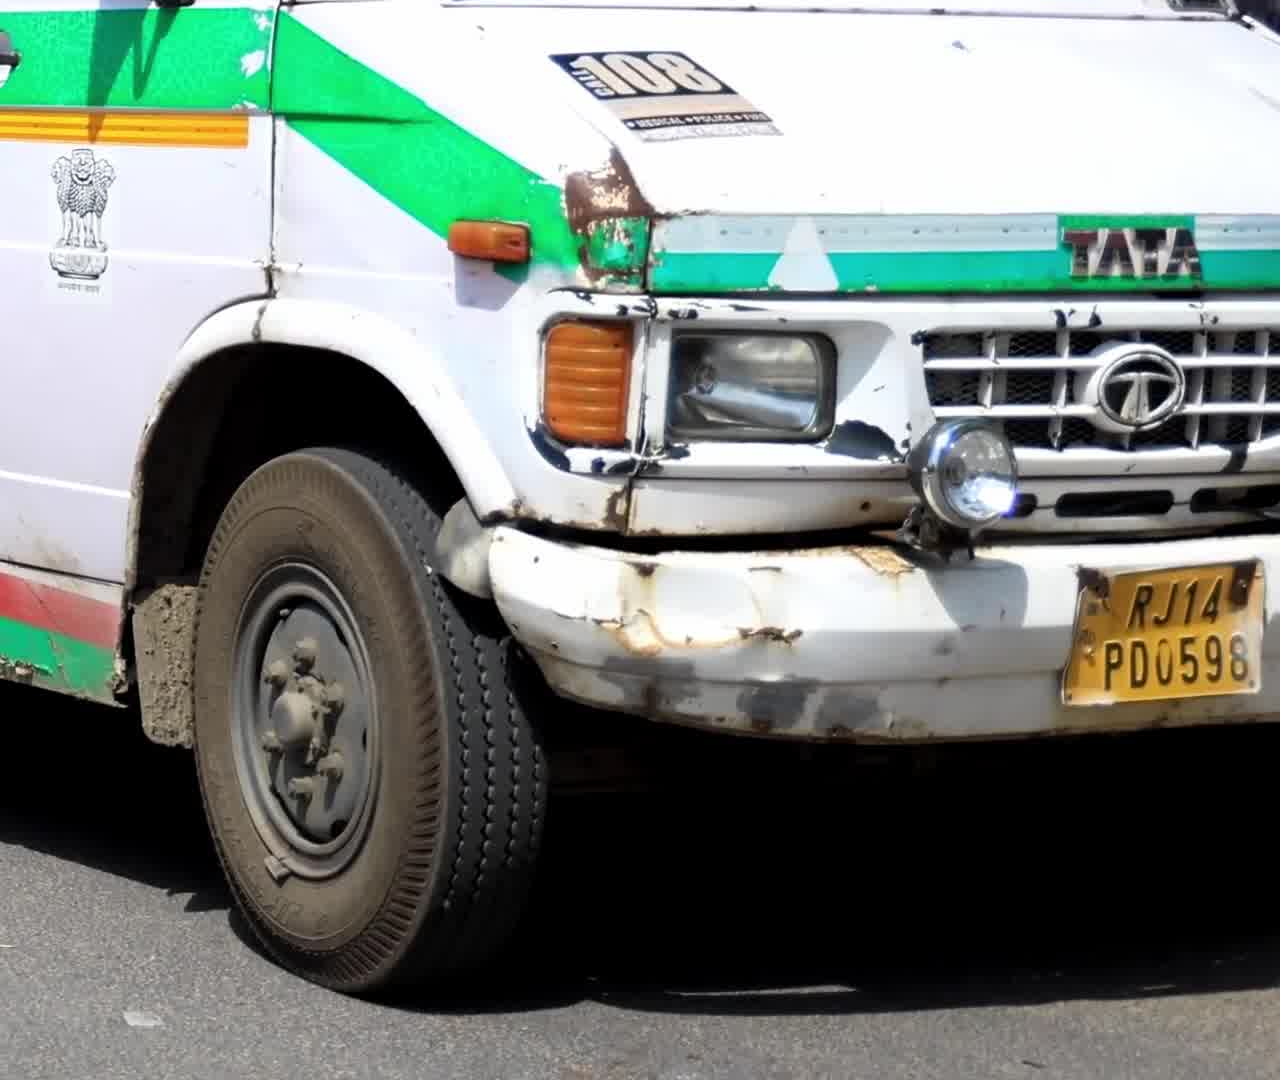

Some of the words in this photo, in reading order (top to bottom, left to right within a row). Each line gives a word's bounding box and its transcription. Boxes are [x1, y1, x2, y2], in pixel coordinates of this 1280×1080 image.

[569, 52, 723, 97] 108
[1062, 229, 1203, 276] TATA
[1125, 576, 1225, 631] RJ14
[1102, 633, 1250, 692] PD0598
